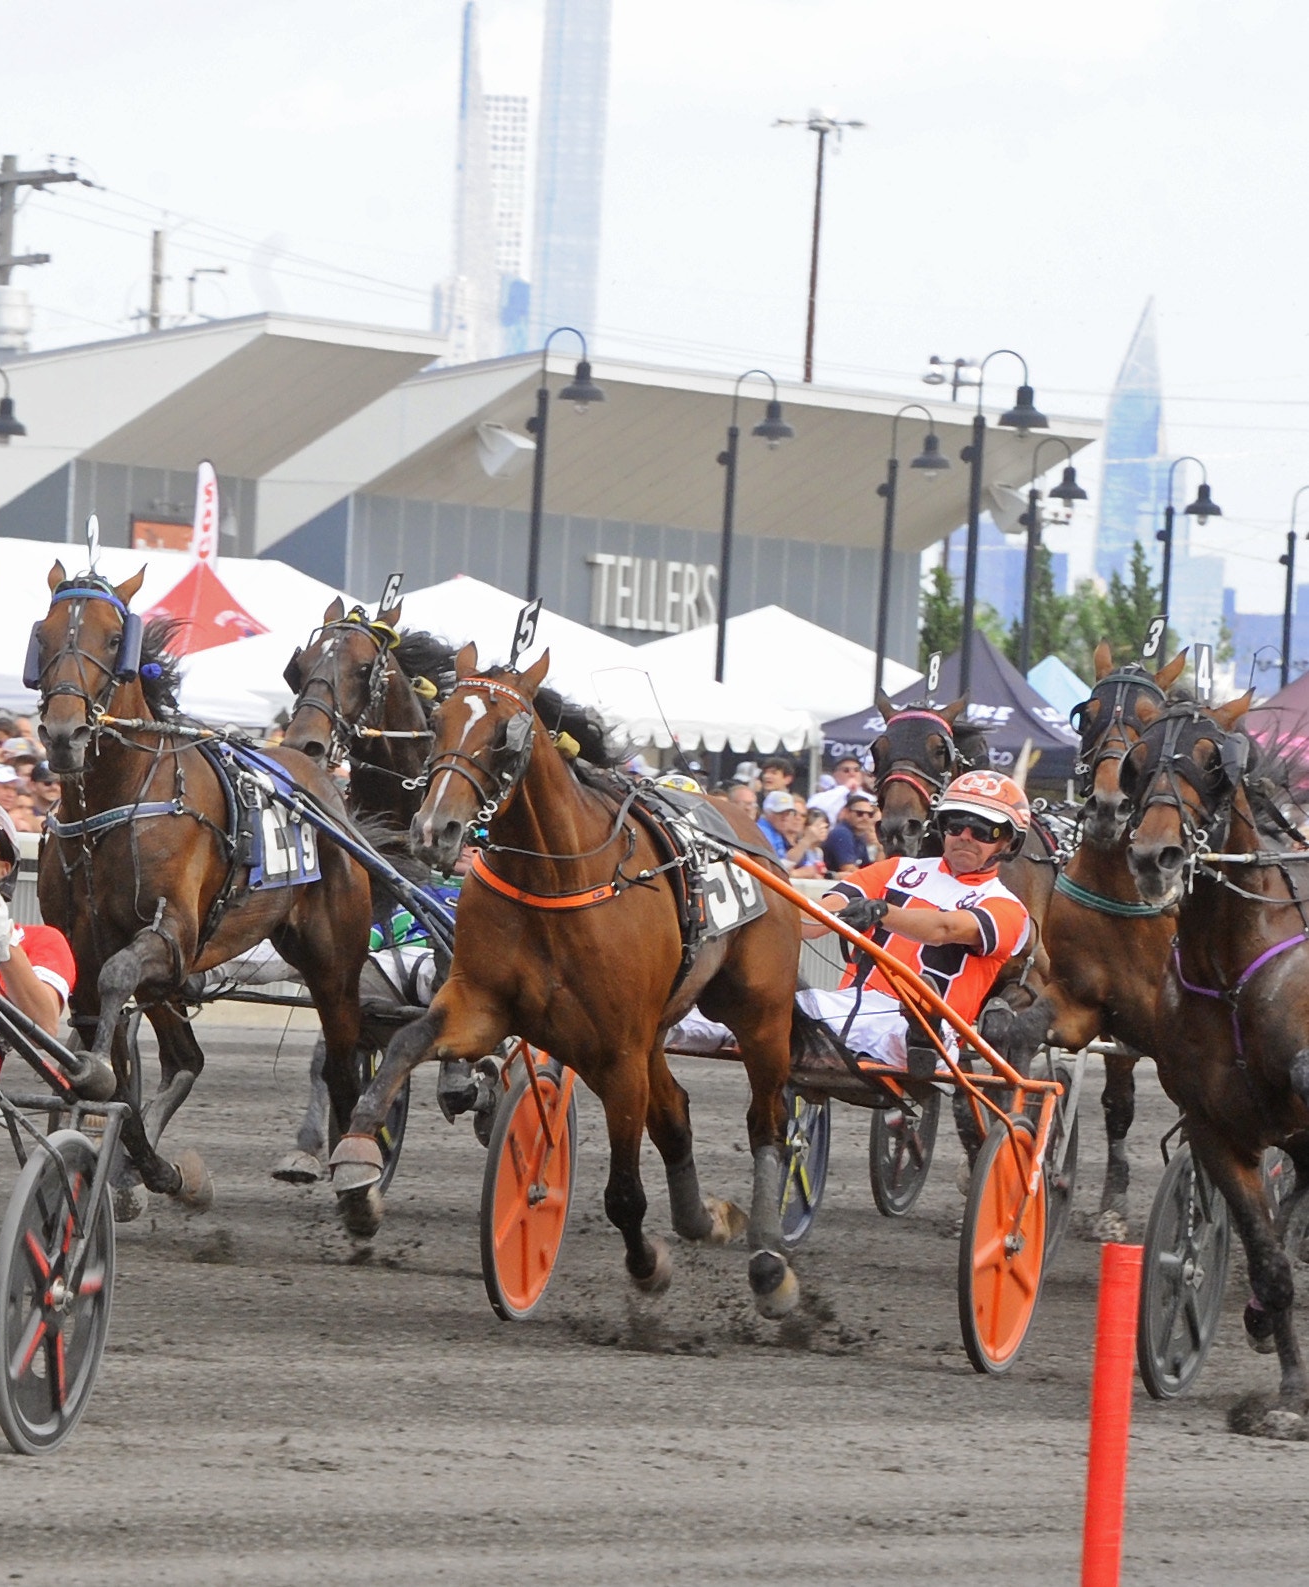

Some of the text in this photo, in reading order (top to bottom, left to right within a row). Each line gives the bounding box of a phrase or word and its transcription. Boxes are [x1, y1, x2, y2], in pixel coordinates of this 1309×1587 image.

[87, 514, 101, 562] 2
[381, 575, 400, 612] 6
[595, 553, 719, 634] TELLERS
[516, 599, 539, 653] 5
[1143, 619, 1165, 657] 3
[928, 655, 941, 691] 8
[1198, 646, 1211, 700] 4
[300, 822, 316, 871] 9
[731, 862, 757, 908] 9
